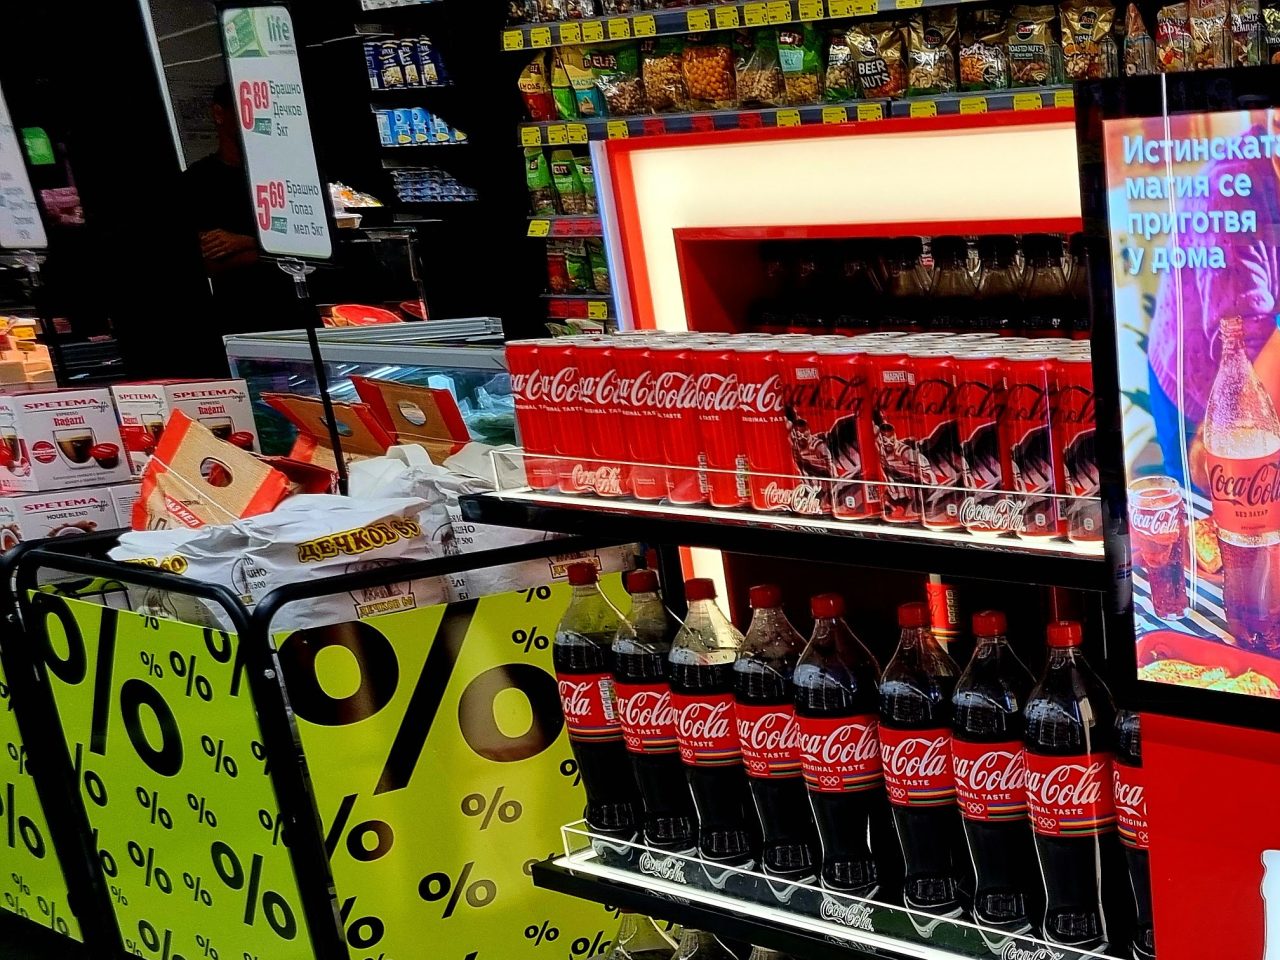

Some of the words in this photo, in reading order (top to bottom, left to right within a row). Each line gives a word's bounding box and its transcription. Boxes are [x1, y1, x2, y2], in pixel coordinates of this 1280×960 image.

[267, 15, 290, 42] life
[858, 59, 885, 75] BEER
[269, 79, 301, 97] Брашно
[862, 72, 890, 89] NUTS
[273, 101, 302, 118] Дечков
[286, 179, 319, 197] Брашно
[1125, 174, 1210, 200] магия
[1218, 173, 1253, 198] се
[288, 200, 313, 216] Топаз
[294, 223, 310, 235] мел
[1127, 209, 1257, 240] приготвя
[1127, 248, 1145, 276] у
[1150, 246, 1227, 273] дома
[118, 393, 158, 401] SPETEMA
[172, 388, 238, 399] SPETEMA
[24, 397, 99, 411] SPETEMA
[198, 404, 226, 415] Ragazzi
[53, 415, 85, 427] Ragazzi
[24, 496, 98, 513] SPETEMA
[47, 511, 68, 521] HOUSE
[67, 510, 89, 520] BLEND
[959, 497, 1027, 532] Coca-Cola
[1130, 506, 1180, 536] Coca-Cola
[297, 522, 397, 563] ДЕЧКОВ
[988, 792, 1012, 800] TASTE
[1053, 807, 1084, 816] TASTE
[820, 896, 875, 932] Coca-Cola
